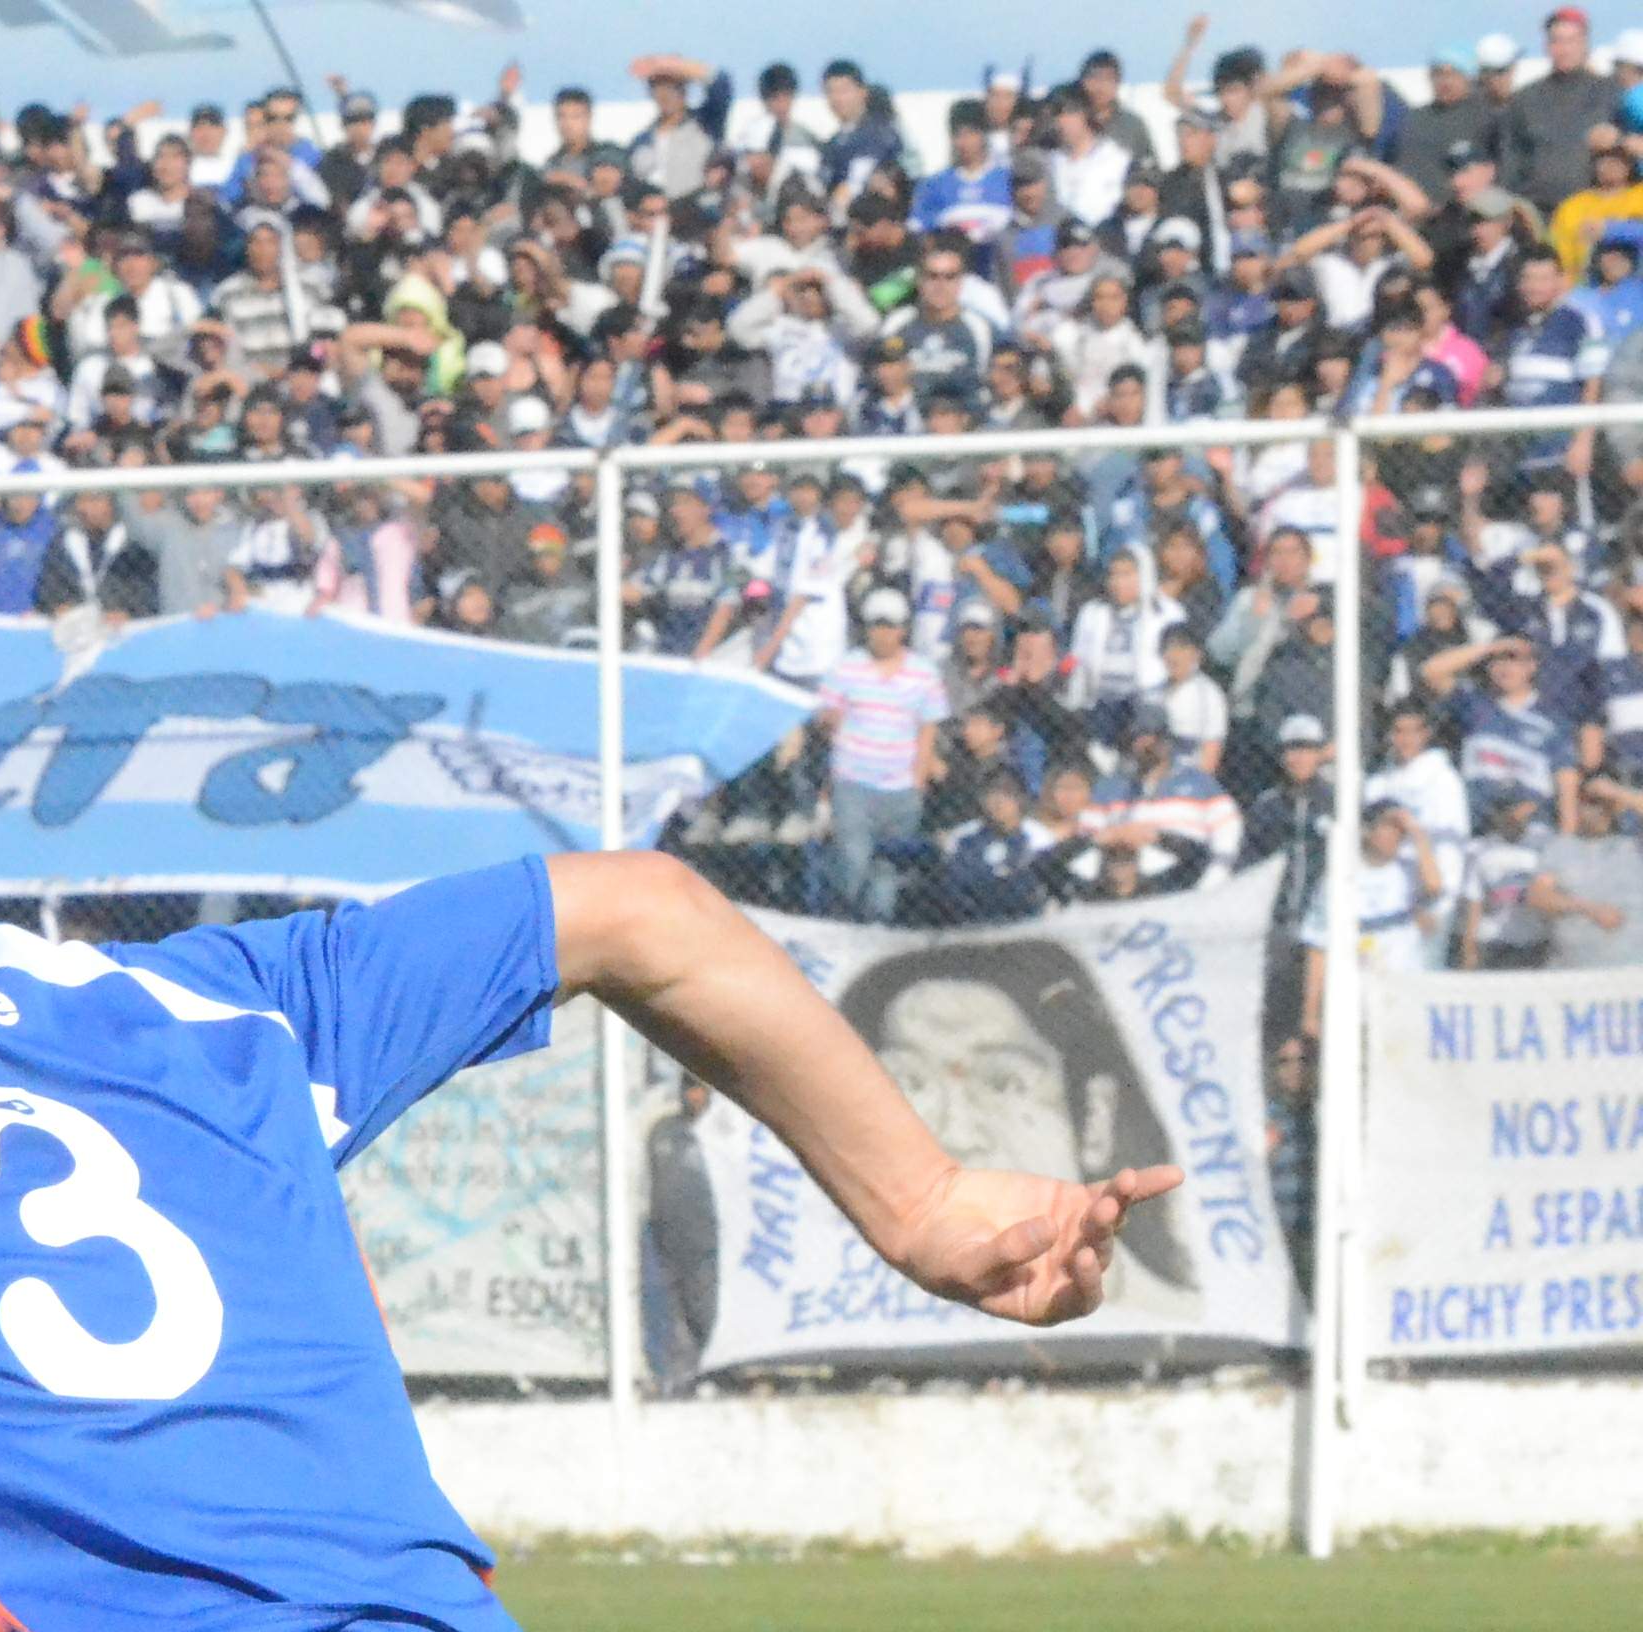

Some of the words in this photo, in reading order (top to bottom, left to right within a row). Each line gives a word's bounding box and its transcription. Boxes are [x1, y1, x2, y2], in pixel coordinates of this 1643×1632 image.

[1427, 1002, 1474, 1062] NI
[1492, 1002, 1548, 1062] LA
[1491, 1099, 1581, 1157] NOS
[1484, 1194, 1514, 1251] A
[1390, 1281, 1523, 1343] RICHY
